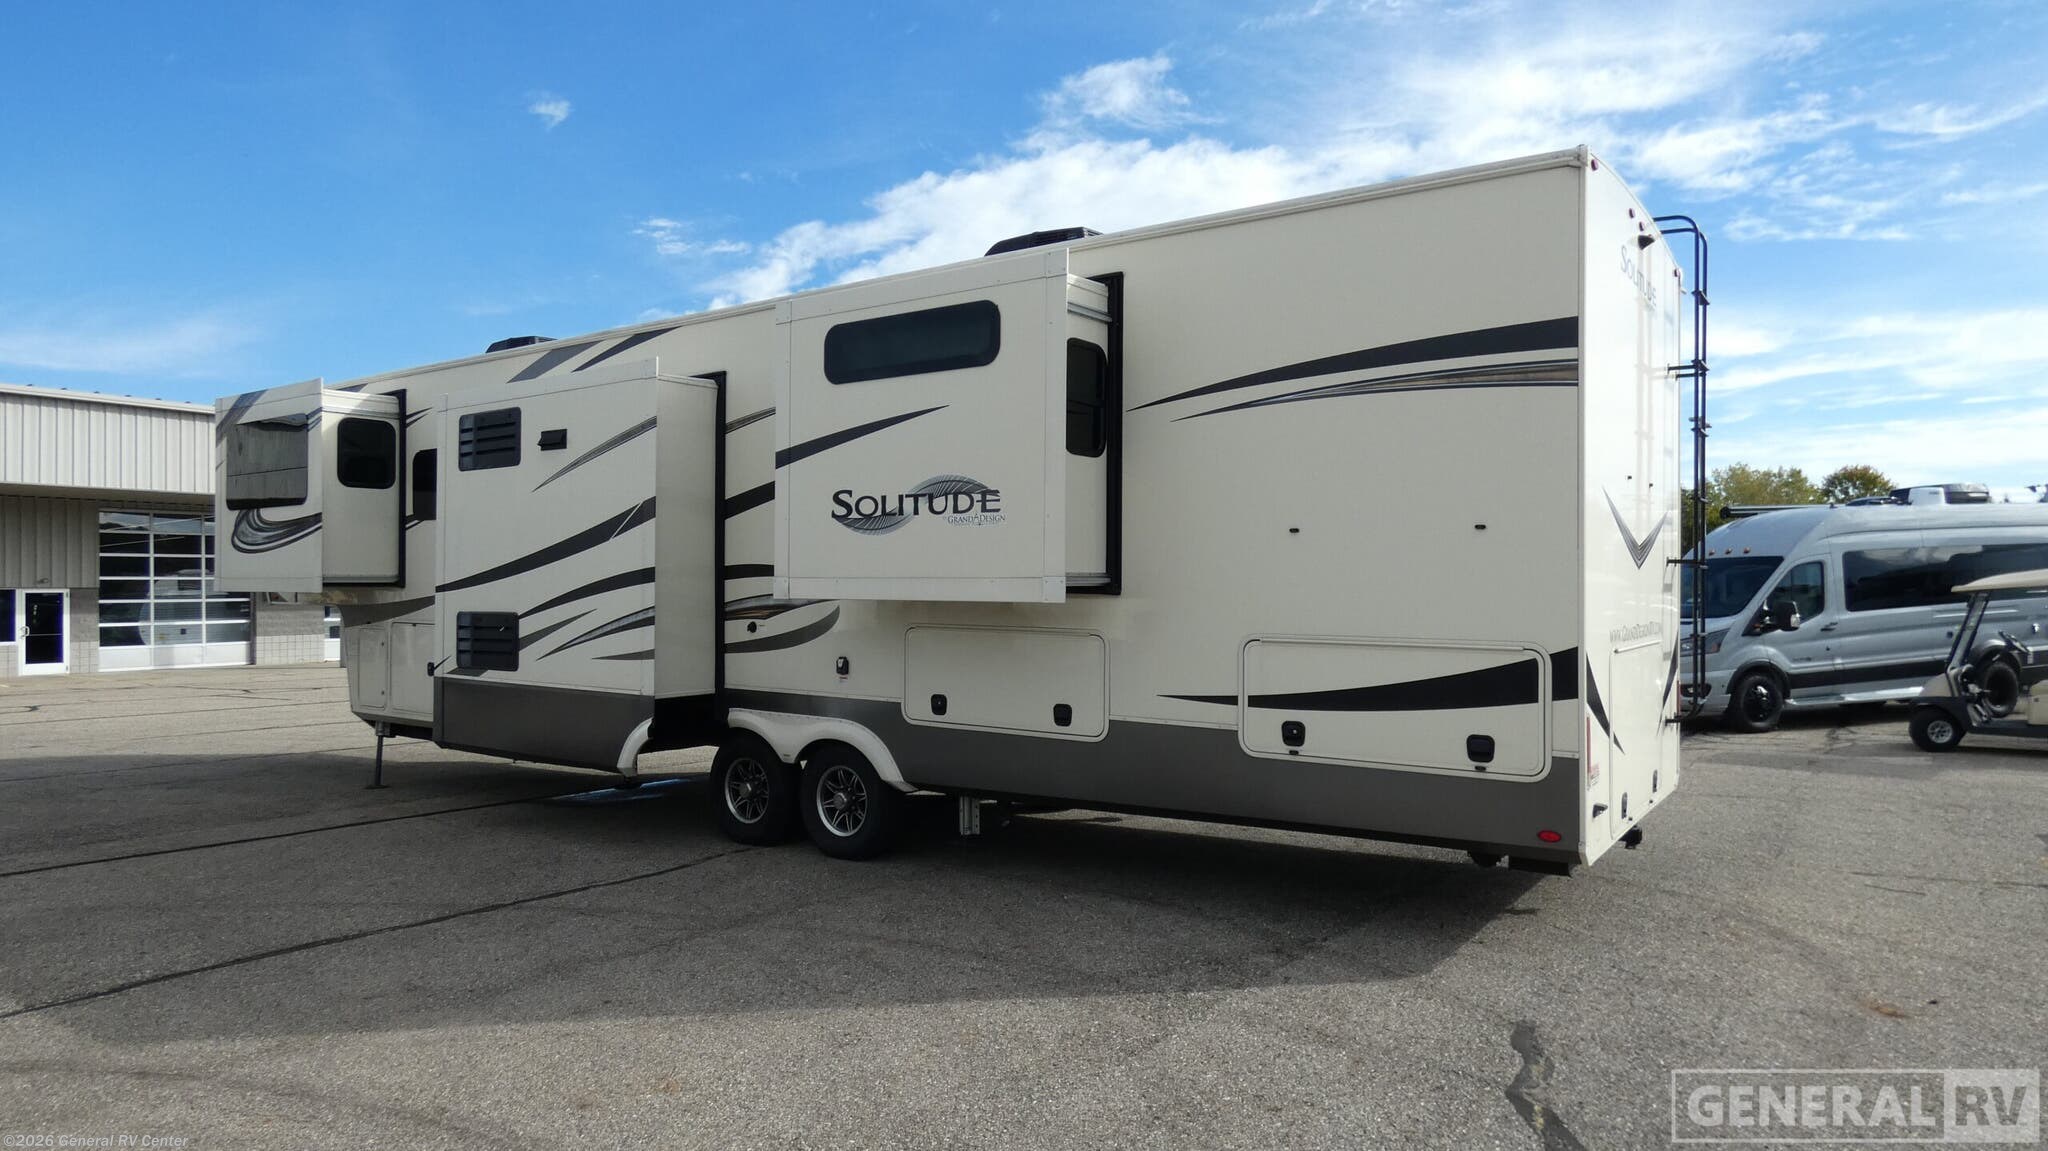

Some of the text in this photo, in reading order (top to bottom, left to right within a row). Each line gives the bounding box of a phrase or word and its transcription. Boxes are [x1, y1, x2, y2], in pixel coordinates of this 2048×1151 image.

[831, 489, 1001, 518] SOLITUDE
[948, 515, 974, 524] GRAND
[980, 514, 1006, 523] DESIGN
